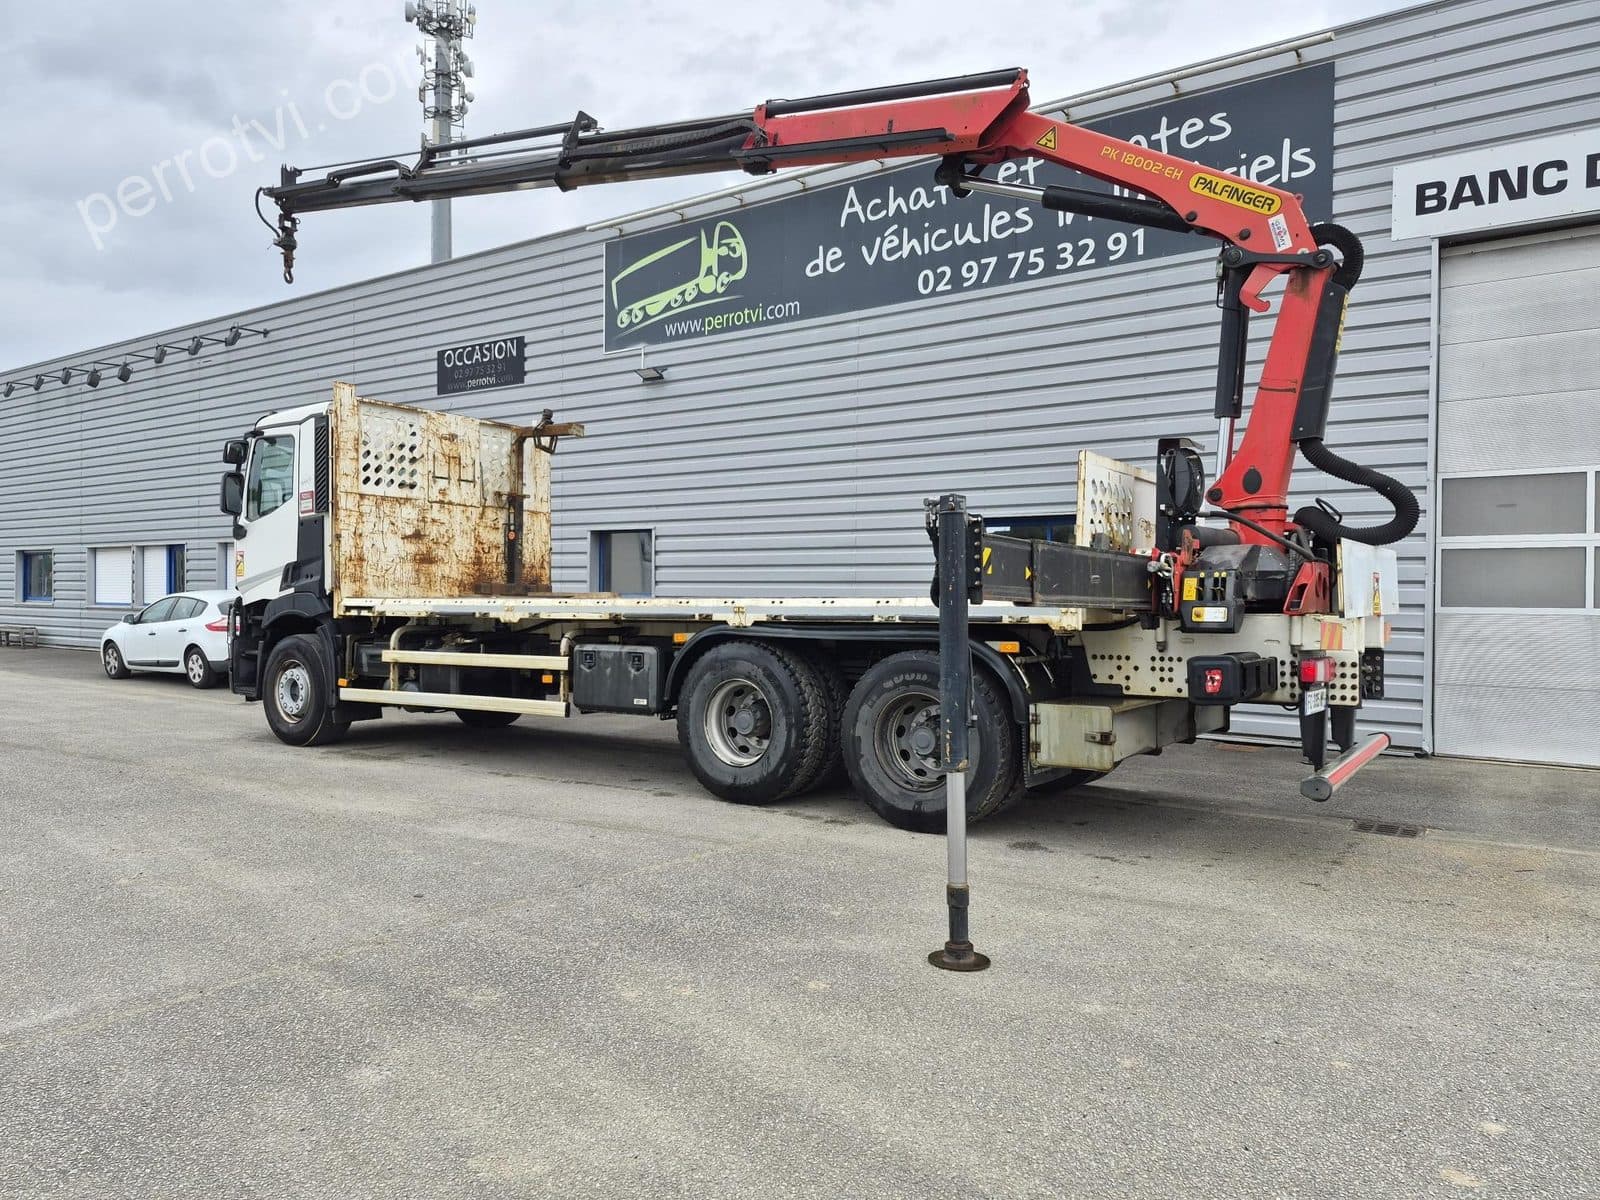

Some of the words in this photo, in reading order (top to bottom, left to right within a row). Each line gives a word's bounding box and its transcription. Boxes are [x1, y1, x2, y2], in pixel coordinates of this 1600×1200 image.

[1100, 146, 1119, 160] PK
[840, 184, 974, 228] Achat
[997, 156, 1045, 185] et
[1193, 176, 1275, 212] PALFINGER
[1415, 159, 1568, 216] BANC
[805, 245, 846, 277] de
[861, 204, 1034, 266] véhicules
[917, 266, 952, 294] 02
[961, 257, 998, 287] 97
[1008, 248, 1045, 279] 75
[1055, 238, 1096, 270] 32
[1106, 228, 1146, 261] 91
[665, 300, 800, 337] www.perrotvi.com
[444, 339, 517, 368] OCCASION
[447, 374, 514, 391] www.perrotvi.com
